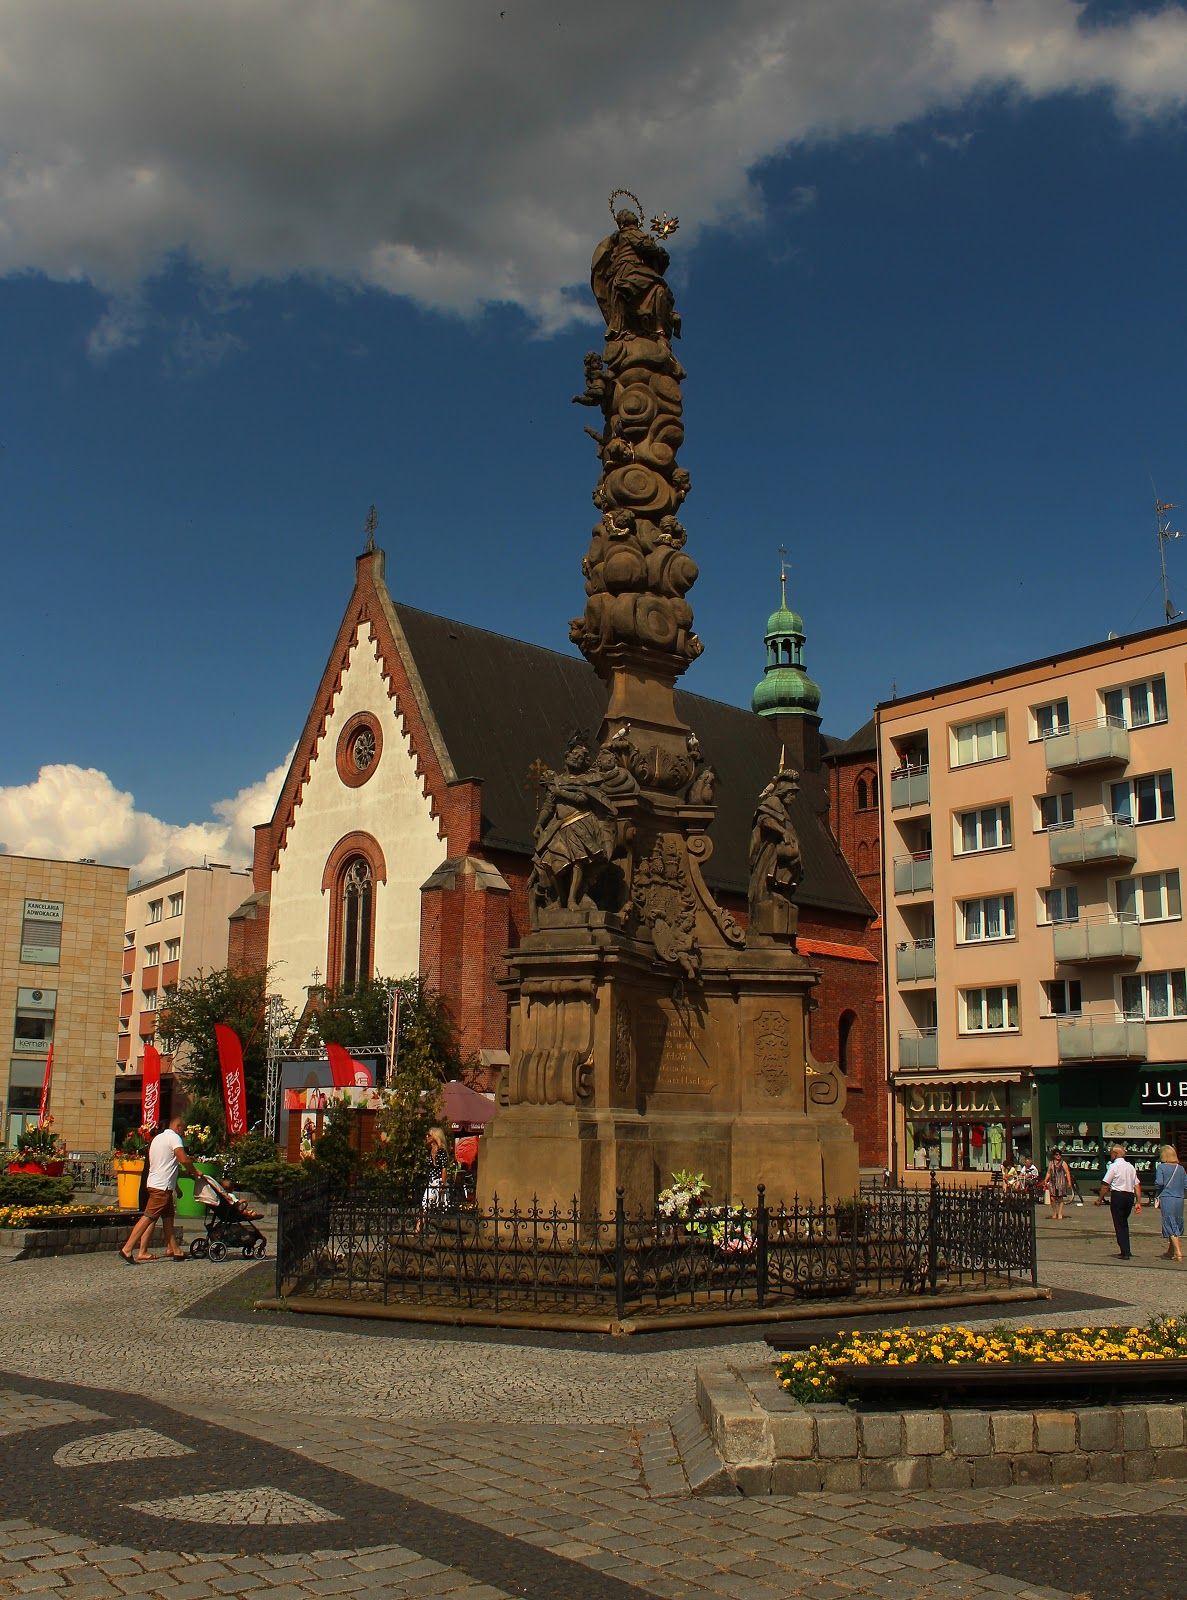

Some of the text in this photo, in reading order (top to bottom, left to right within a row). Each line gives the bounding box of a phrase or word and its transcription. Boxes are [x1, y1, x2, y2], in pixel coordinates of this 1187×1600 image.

[26, 910, 60, 918] ADWOKACKA
[27, 902, 60, 911] KANCELARIA
[226, 1067, 243, 1133] Coca-Cola
[910, 1087, 1001, 1111] STELLA
